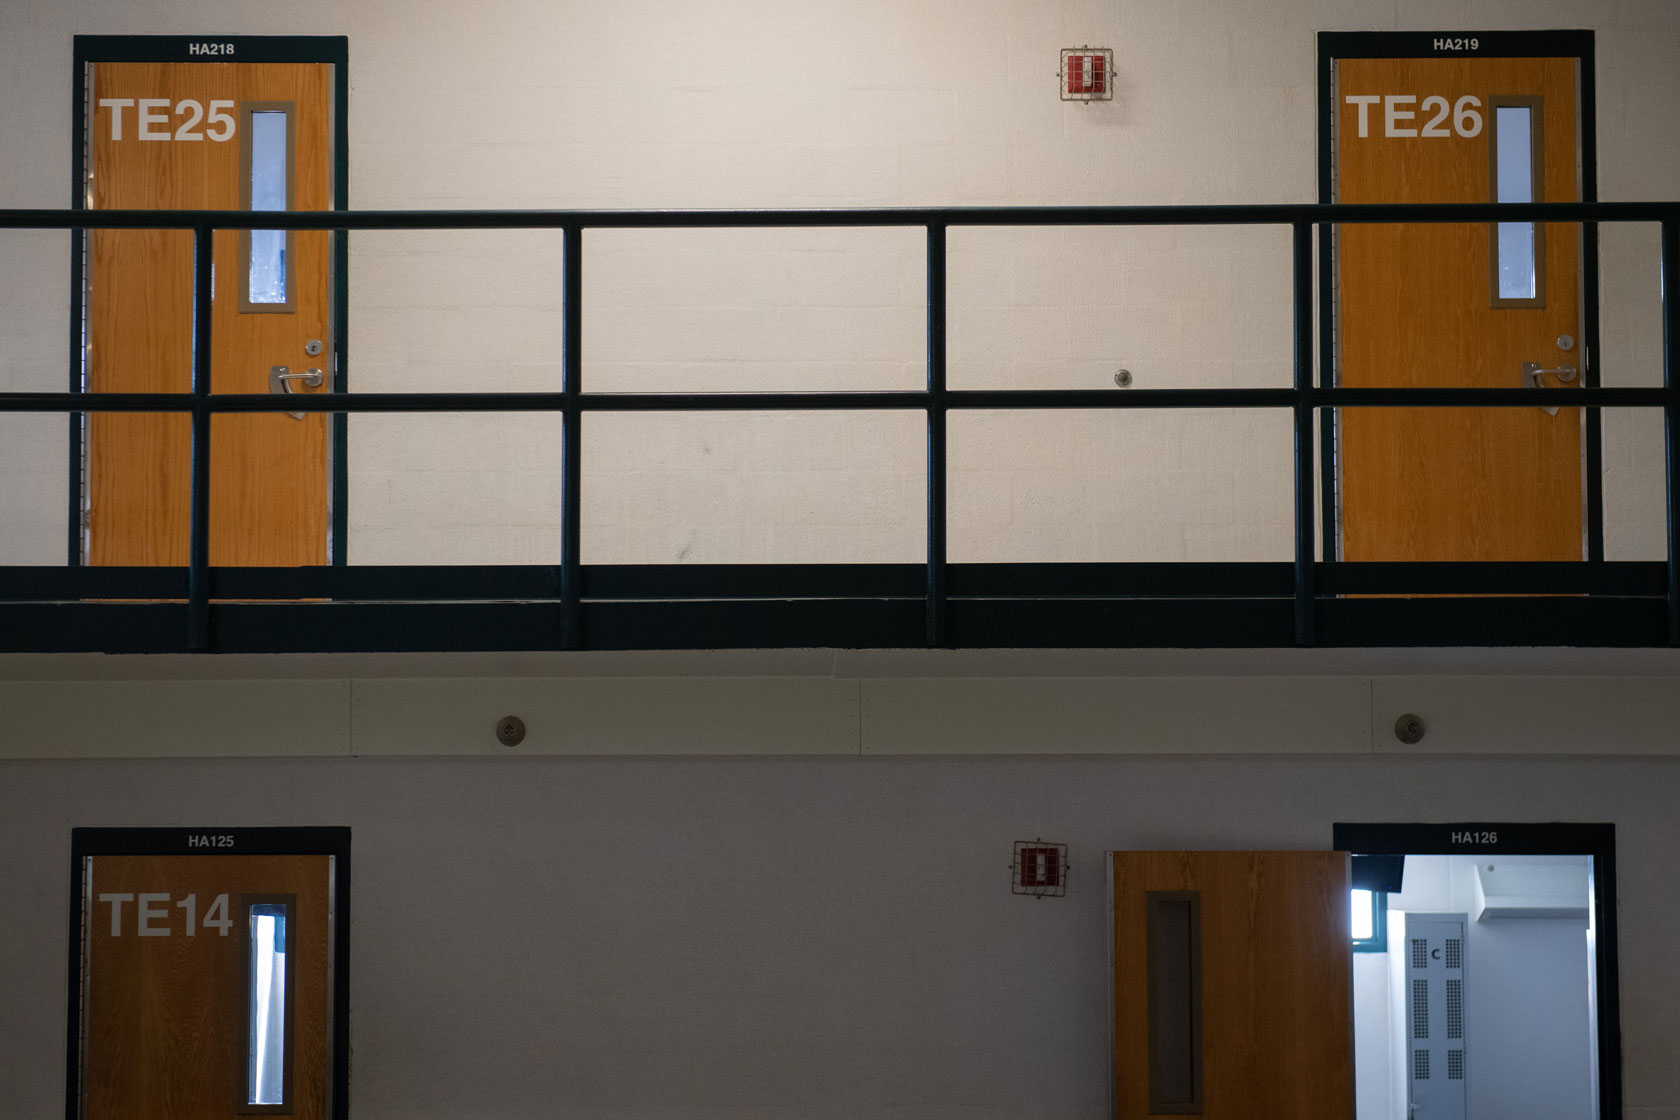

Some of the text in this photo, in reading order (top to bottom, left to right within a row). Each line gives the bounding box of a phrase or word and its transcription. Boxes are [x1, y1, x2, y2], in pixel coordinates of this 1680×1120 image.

[189, 43, 235, 55] HA218
[1433, 38, 1479, 51] HA219
[99, 98, 236, 142] TE25
[1345, 94, 1483, 138] TE26
[188, 835, 235, 847] HA125
[1451, 831, 1498, 844] HA126
[99, 892, 234, 937] TE14
[1431, 948, 1441, 961] C
